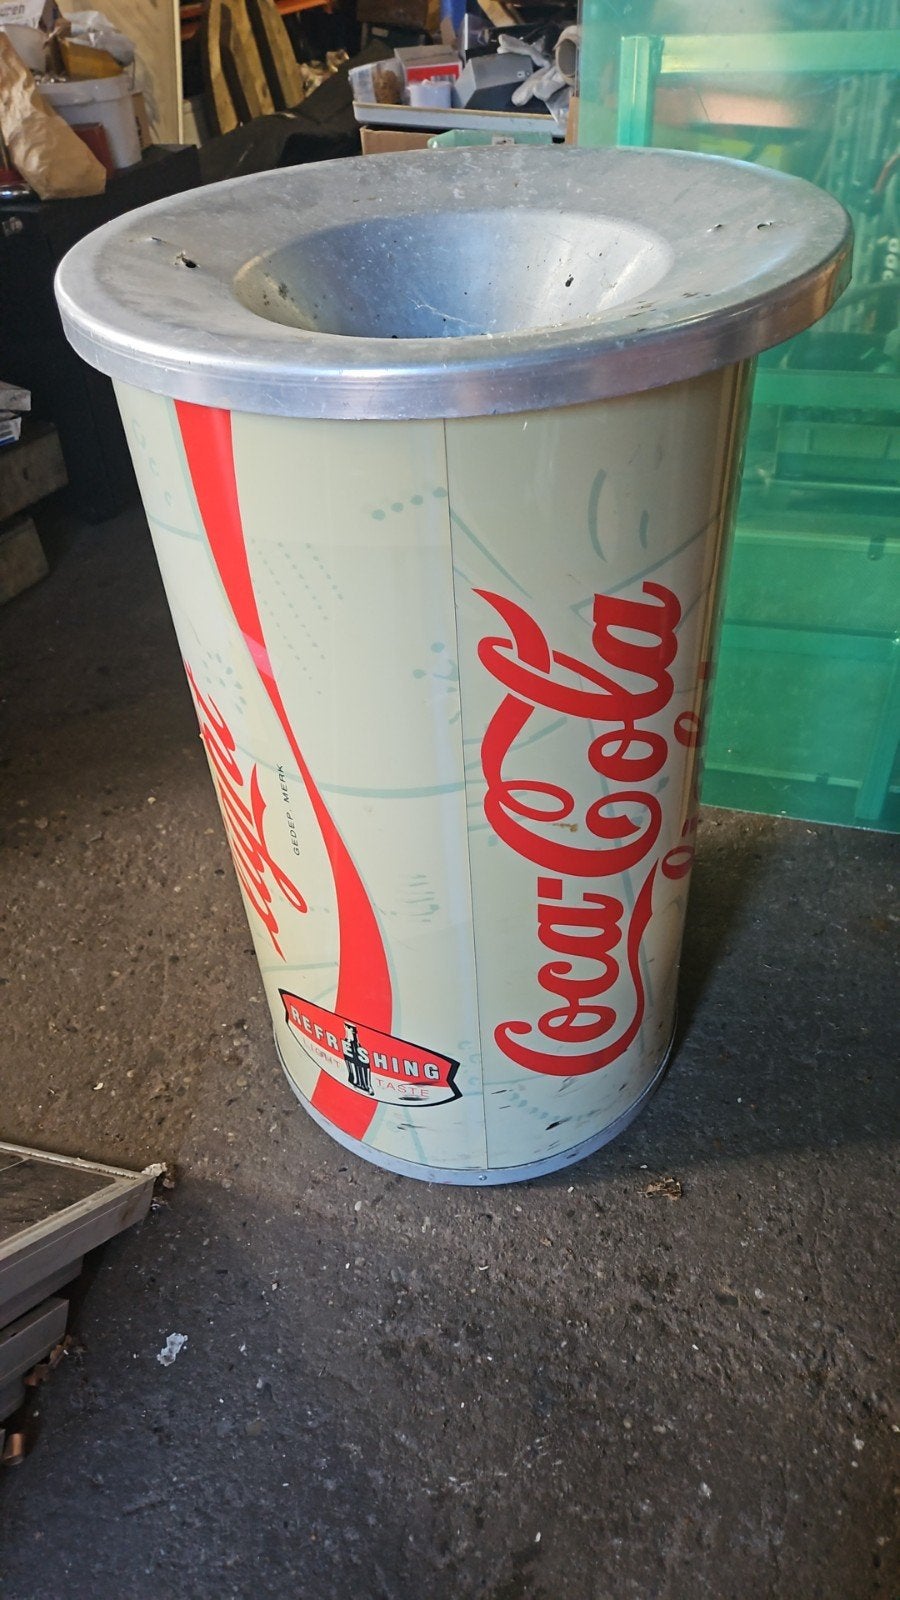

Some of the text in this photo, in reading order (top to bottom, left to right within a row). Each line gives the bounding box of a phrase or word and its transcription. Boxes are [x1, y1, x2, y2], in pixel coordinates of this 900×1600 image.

[277, 764, 300, 856] GEDEP. MERK
[471, 580, 682, 1076] Coca-Cola
[289, 1004, 441, 1081] REFRESHING
[376, 1078, 430, 1098] TASTE
